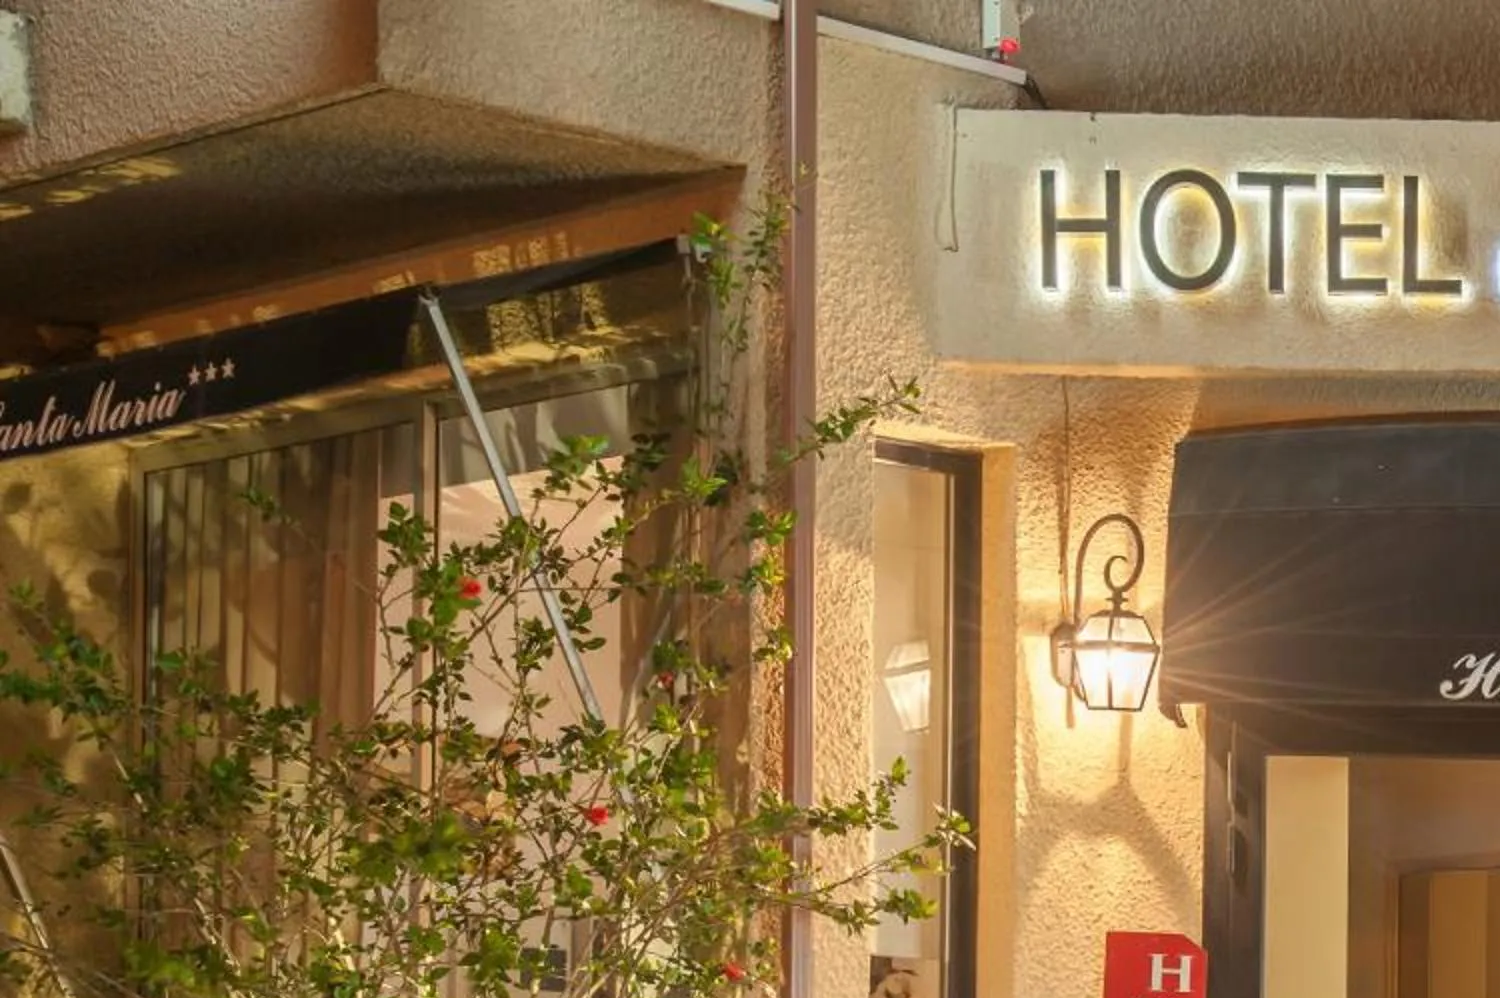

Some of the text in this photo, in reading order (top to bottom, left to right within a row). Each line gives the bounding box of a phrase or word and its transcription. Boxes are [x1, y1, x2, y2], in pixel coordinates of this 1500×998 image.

[1039, 168, 1463, 297] HOTEL
[0, 379, 187, 451] anta Maria
[1147, 952, 1197, 994] H
